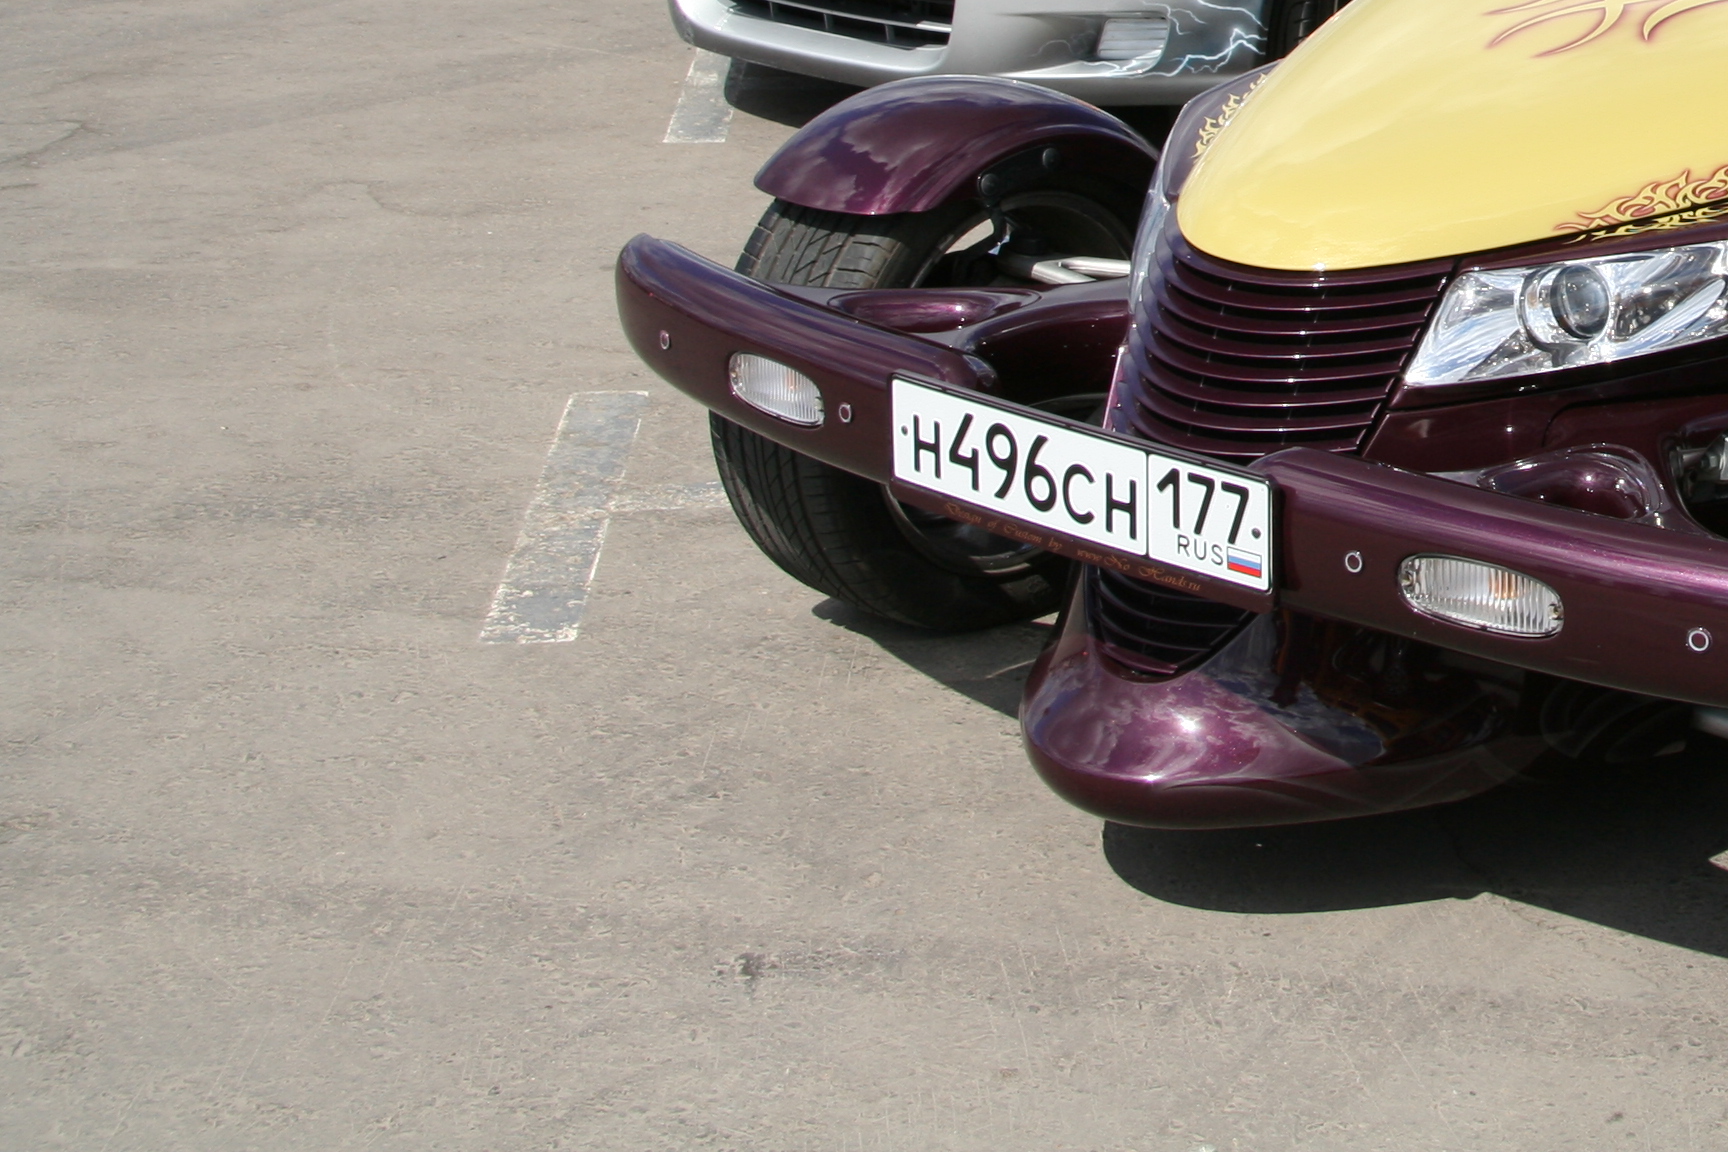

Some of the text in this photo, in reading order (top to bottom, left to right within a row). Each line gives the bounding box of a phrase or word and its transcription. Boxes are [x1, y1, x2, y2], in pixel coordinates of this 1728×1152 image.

[944, 501, 982, 525] Design
[987, 519, 998, 532] of
[1003, 524, 1043, 545] Custom
[1047, 537, 1063, 552] by
[1157, 468, 1250, 545] 177
[1177, 534, 1224, 566] RUS
